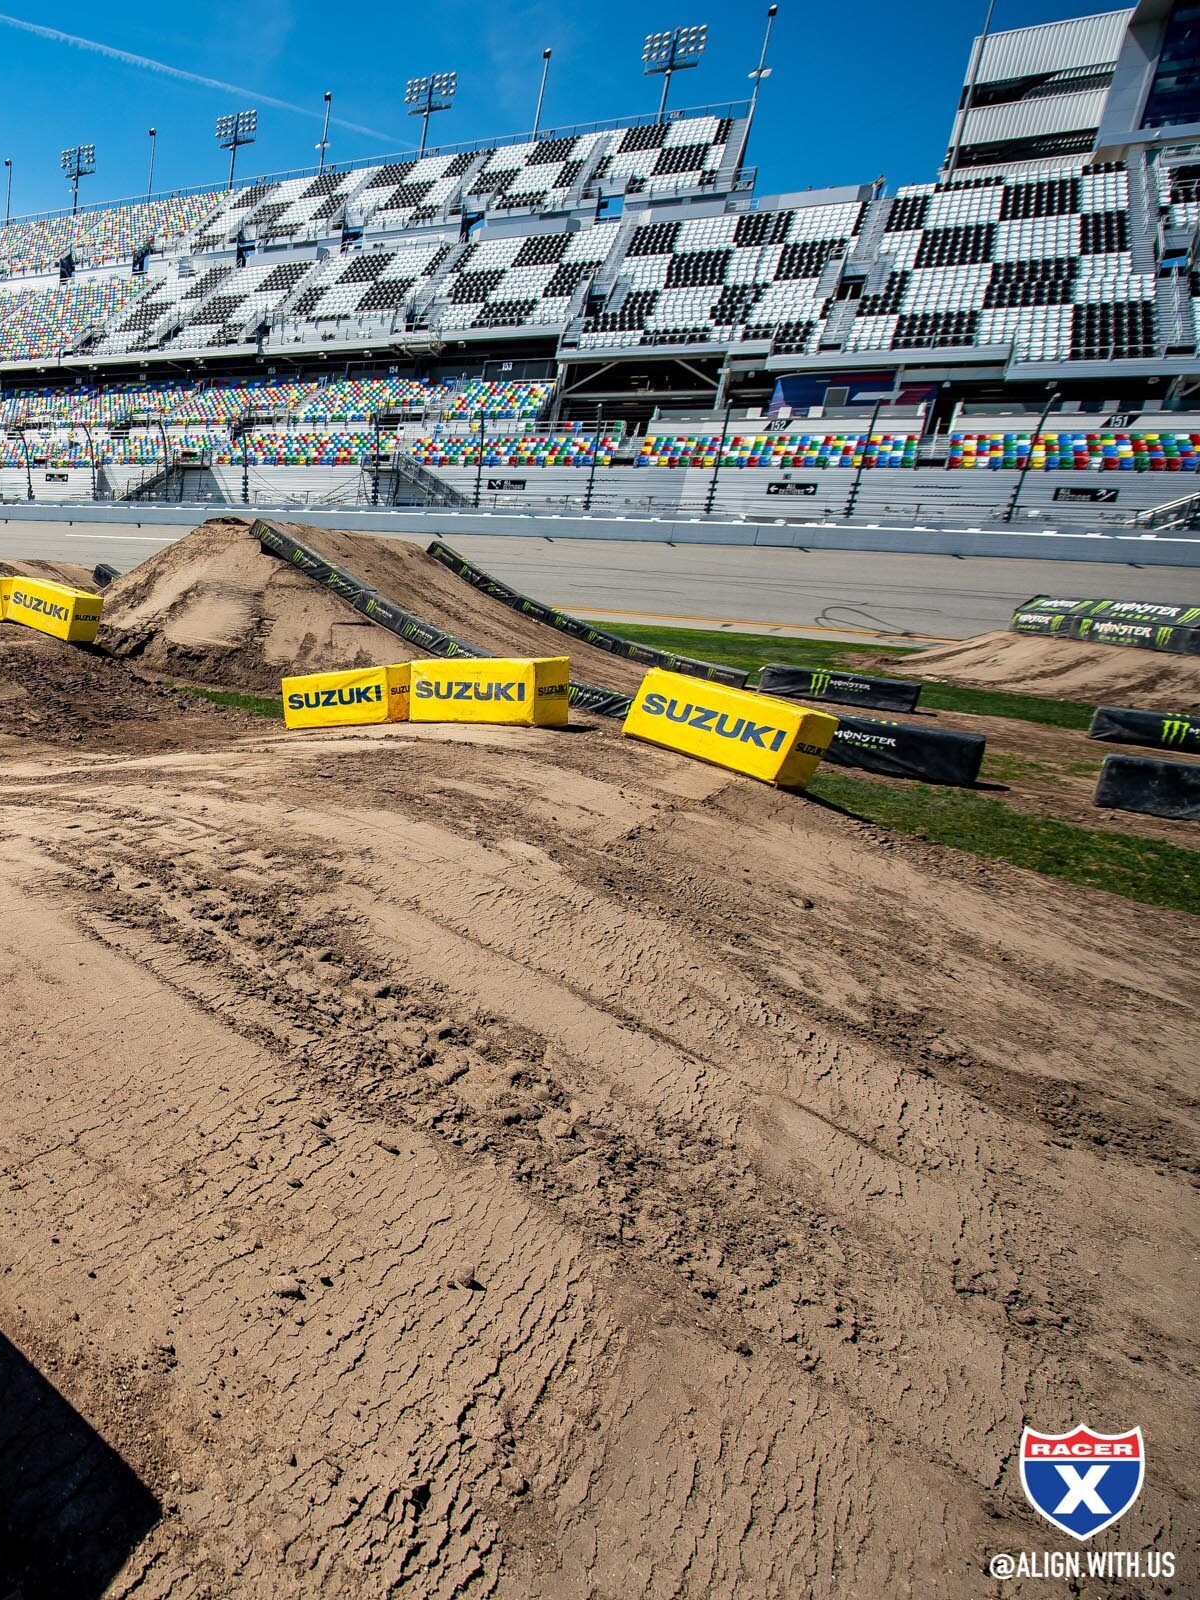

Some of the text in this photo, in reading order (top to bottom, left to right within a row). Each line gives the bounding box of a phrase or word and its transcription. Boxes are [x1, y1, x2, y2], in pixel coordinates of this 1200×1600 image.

[770, 420, 787, 431] 152
[1110, 415, 1129, 428] 151
[13, 591, 69, 621] SUZUKI
[1110, 602, 1181, 618] MONSTER
[1092, 621, 1153, 638] MONSTER
[288, 684, 382, 710] SUZUKI
[390, 684, 410, 697] SUZU
[415, 680, 526, 702] SUZUKI
[537, 682, 568, 697] SUZUKI
[642, 692, 788, 752] SUZUKI
[834, 729, 897, 747] MONSTER
